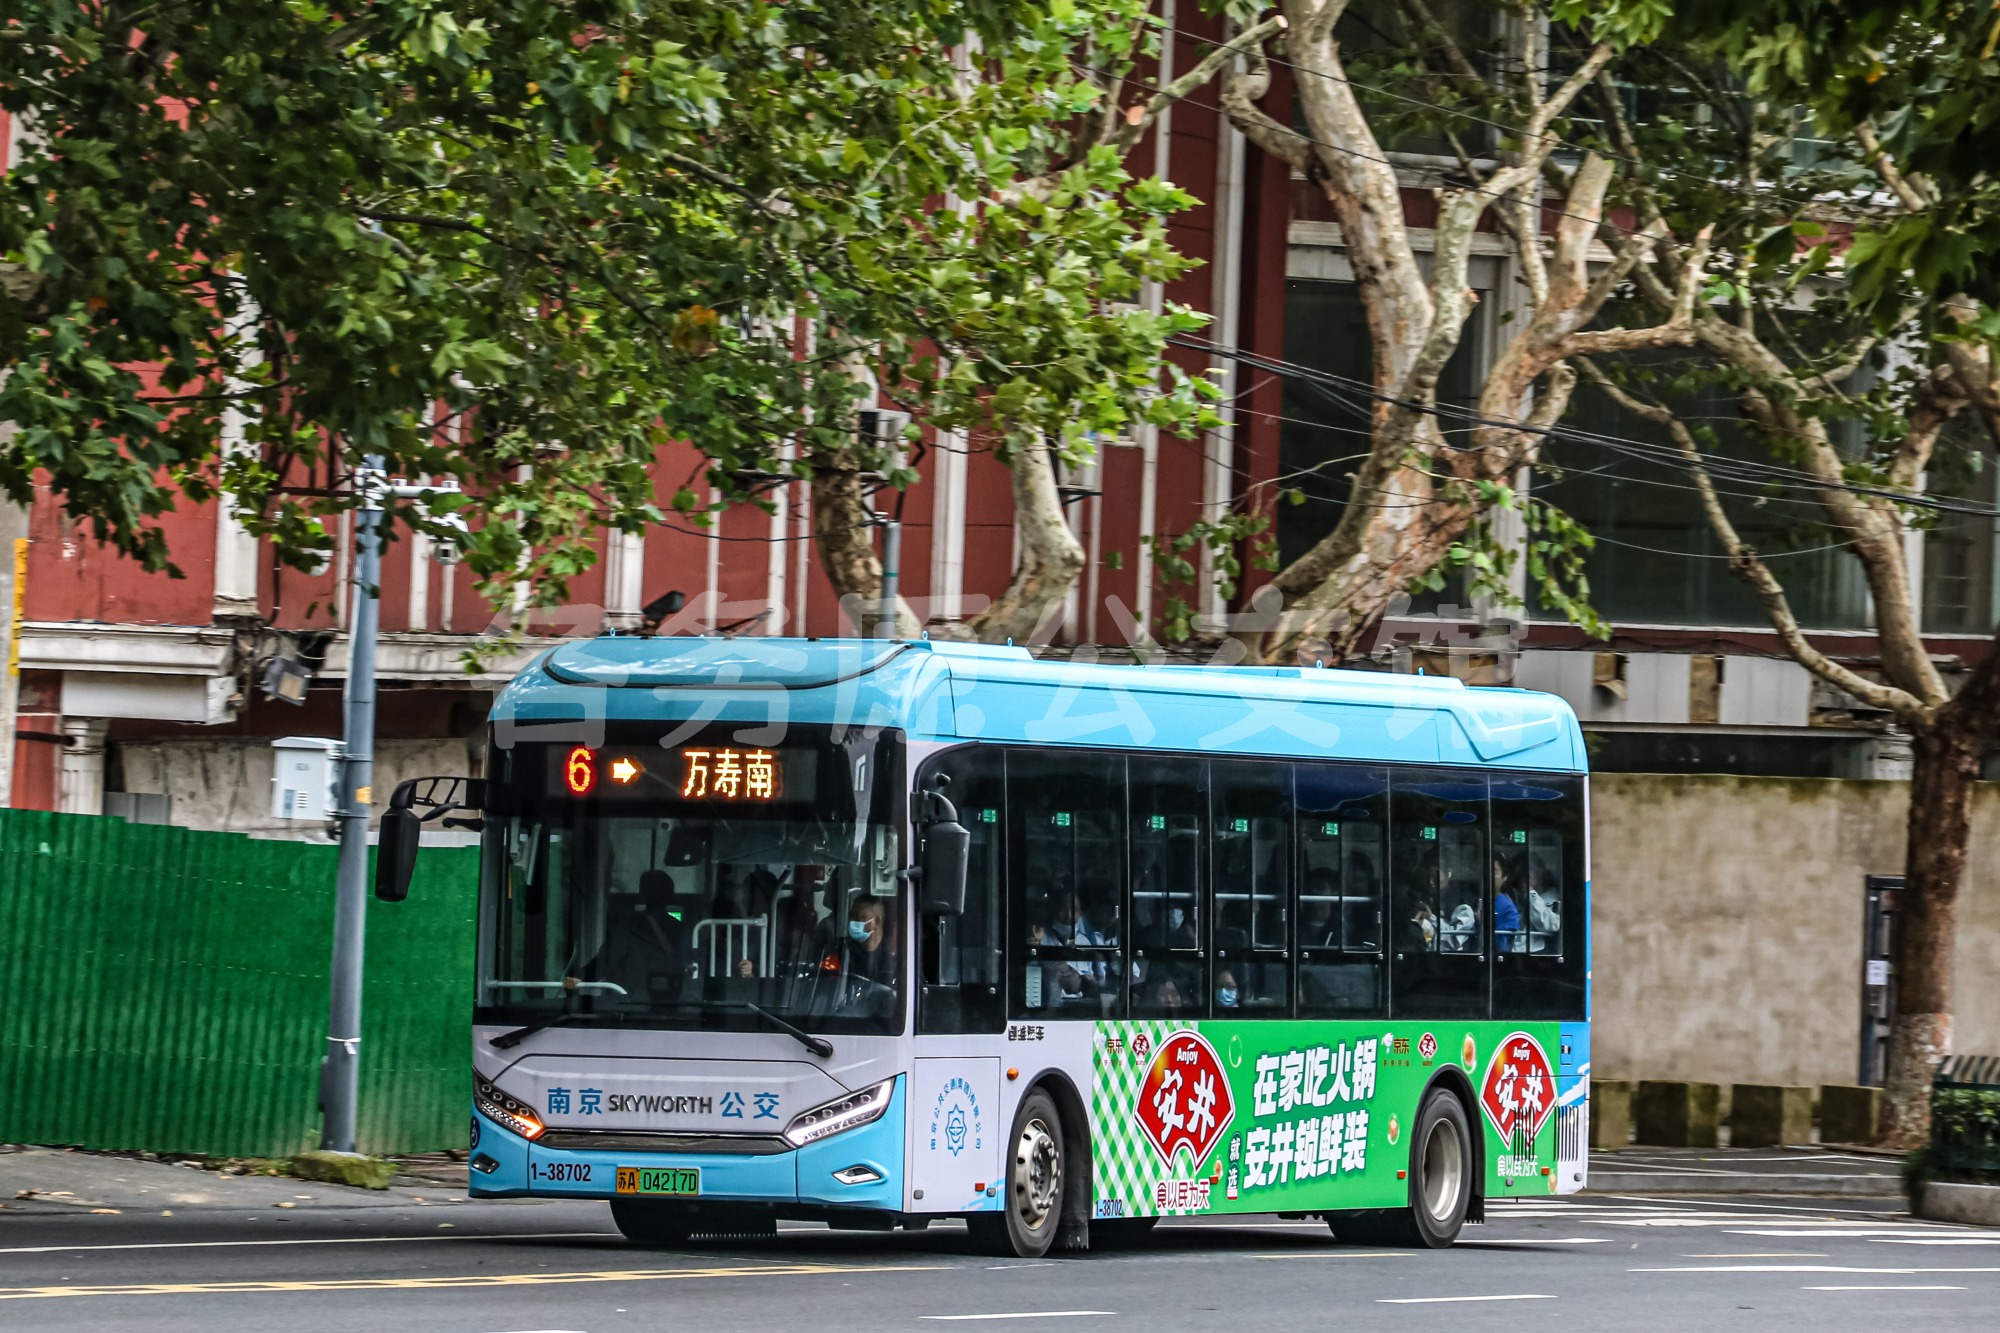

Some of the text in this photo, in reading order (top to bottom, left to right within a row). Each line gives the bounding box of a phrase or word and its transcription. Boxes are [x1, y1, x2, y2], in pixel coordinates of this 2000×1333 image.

[569, 748, 773, 798] 6 万寿南
[1176, 1041, 1199, 1065] Anjoy
[1394, 1038, 1410, 1054] 京东
[1512, 1042, 1531, 1062] Anjoy
[1252, 1038, 1378, 1117] 在家吃火锅
[547, 1087, 780, 1119] 南京 SKYWORTH 公交
[1153, 1068, 1216, 1144] 安井
[1495, 1063, 1544, 1125] 安井
[1243, 1109, 1369, 1189] 安井锁鲜装
[530, 1162, 592, 1182] 1-38702
[643, 1171, 697, 1192] 04217D
[1095, 1199, 1123, 1217] 1-38702
[1157, 1180, 1210, 1209] 食以民为天
